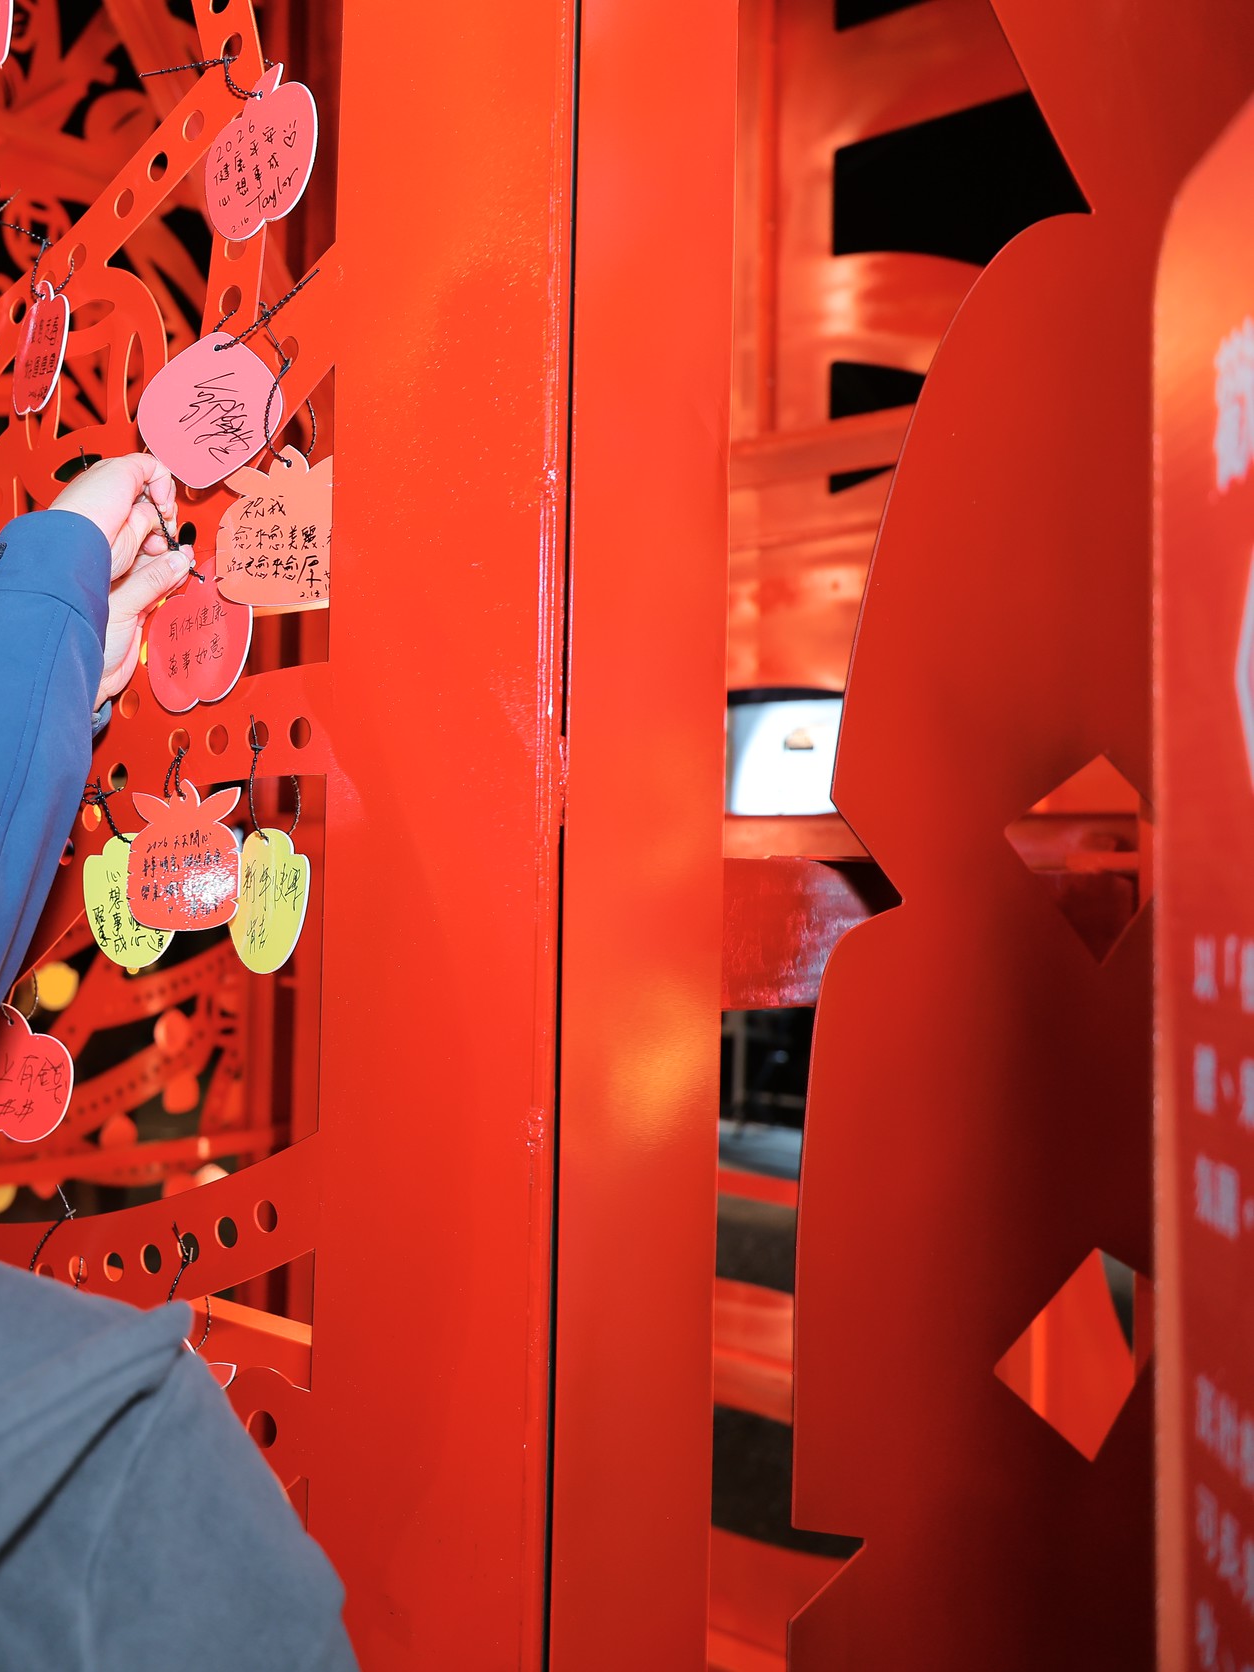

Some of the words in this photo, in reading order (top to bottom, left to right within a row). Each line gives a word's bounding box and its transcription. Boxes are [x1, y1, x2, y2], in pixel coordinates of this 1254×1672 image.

[213, 126, 277, 186] 健康平安
[215, 119, 255, 164] 2026
[218, 152, 280, 207] 心想事成
[245, 167, 299, 213] Taylor
[230, 217, 250, 233] 2.16
[239, 495, 286, 521] 祝我
[167, 633, 225, 680] 萬事如意
[105, 869, 128, 956] 心想事成
